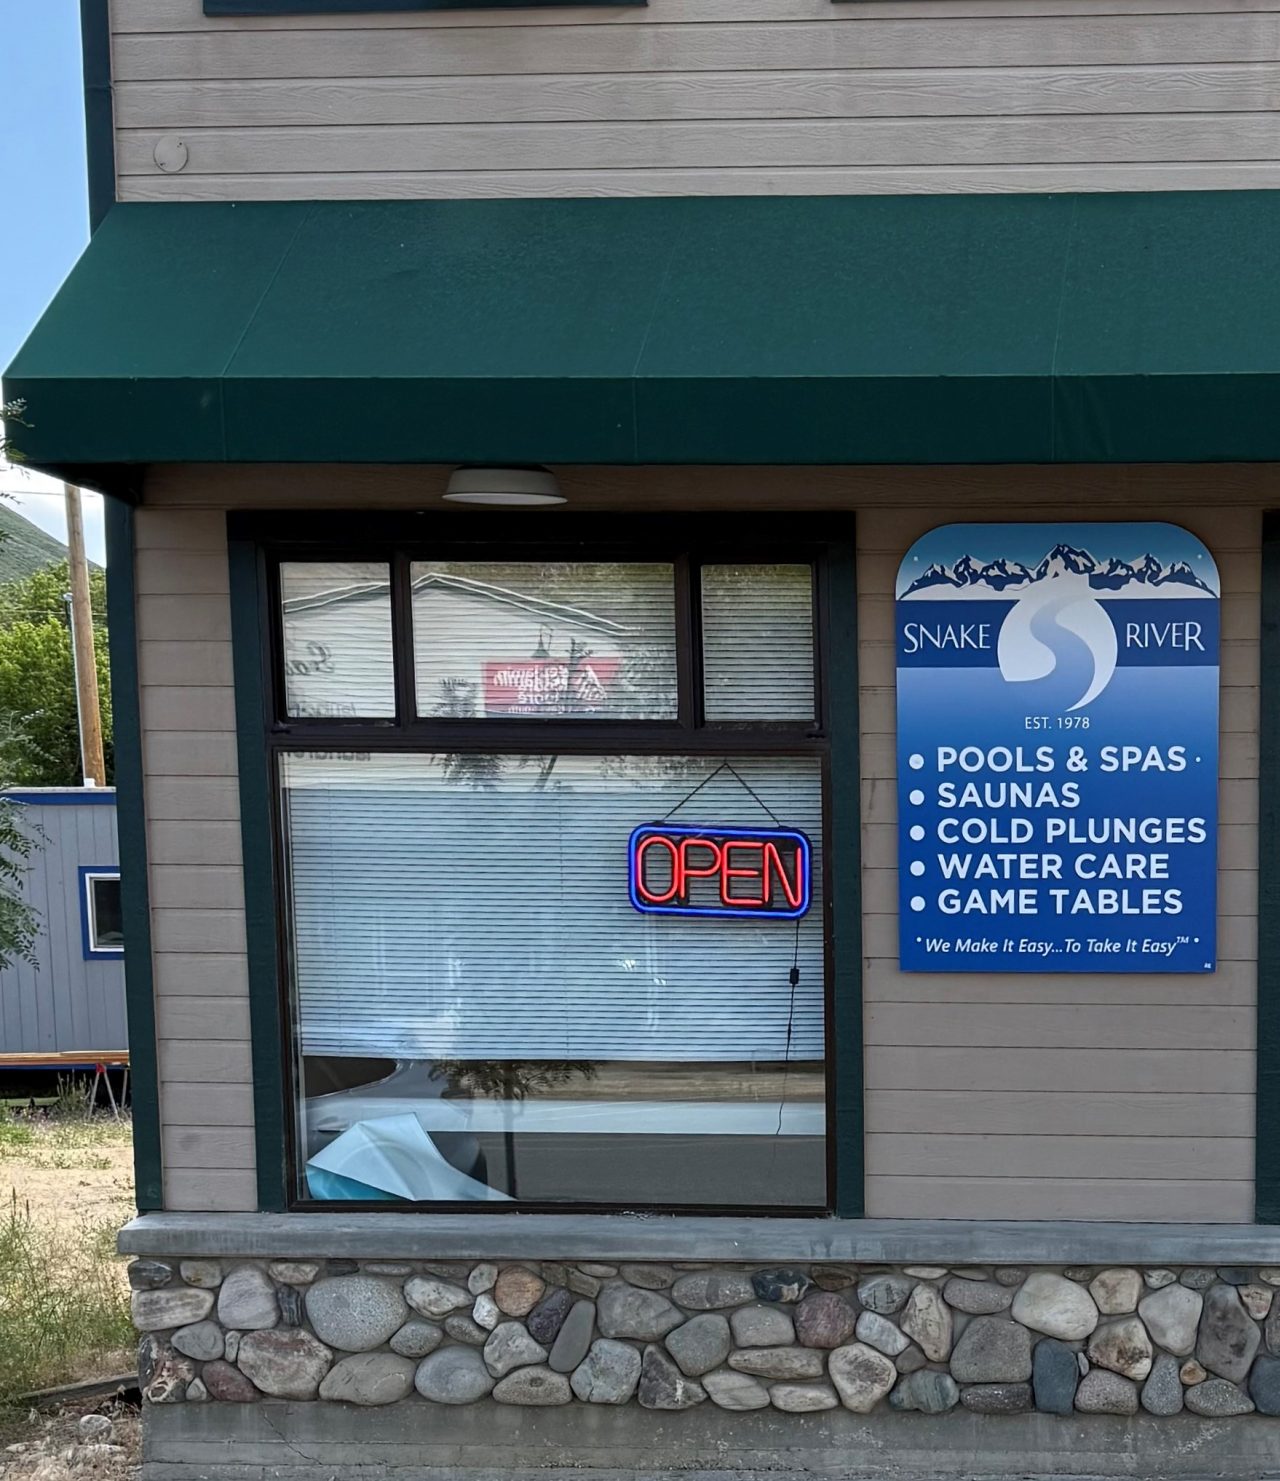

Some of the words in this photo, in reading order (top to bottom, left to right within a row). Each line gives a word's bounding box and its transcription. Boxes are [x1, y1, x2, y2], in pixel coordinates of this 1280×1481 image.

[903, 622, 991, 653] SNAKE
[1126, 621, 1205, 651] RIVER
[1024, 716, 1052, 730] EST.
[1057, 716, 1090, 729] 1978
[937, 746, 1055, 772] POOLS
[1066, 745, 1088, 772] &
[1100, 745, 1187, 772] SPAS
[938, 782, 1080, 808] SAUNAS
[937, 817, 1034, 844] COLD
[1046, 817, 1207, 844] PLUNGES
[636, 835, 803, 907] OPEN
[937, 853, 1063, 879] WATER
[1074, 853, 1169, 879] CARE
[938, 888, 1038, 914] GAME
[1049, 888, 1183, 915] TABLES
[925, 937, 951, 953] We
[954, 937, 999, 953] Make
[1002, 938, 1016, 953] It
[1086, 938, 1122, 953] Take
[1125, 938, 1138, 953] It
